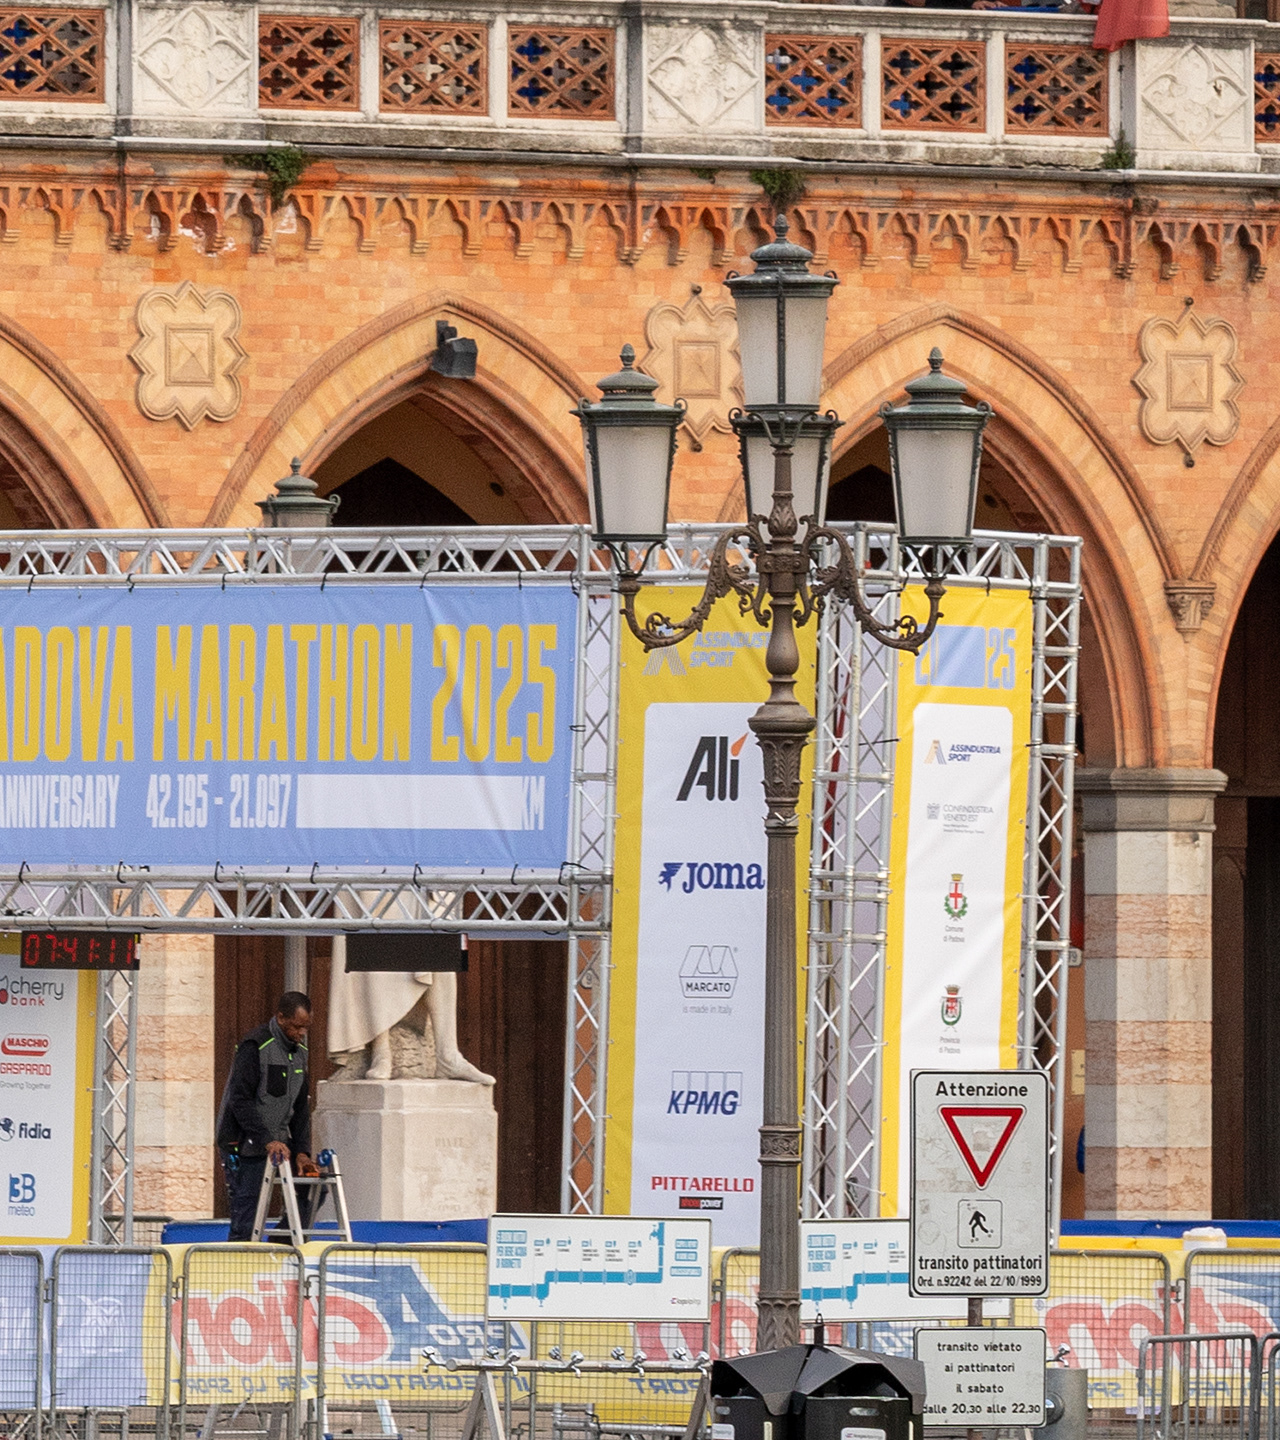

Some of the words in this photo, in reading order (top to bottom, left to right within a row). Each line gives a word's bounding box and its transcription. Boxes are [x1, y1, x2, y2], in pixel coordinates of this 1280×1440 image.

[694, 631, 772, 648] ASSINDUST
[689, 651, 736, 668] SPORT
[152, 624, 413, 762] MARATHON
[430, 624, 558, 763] 2025
[949, 744, 1002, 755] ASSINDUSTRIA
[948, 753, 972, 762] SPORT
[145, 773, 209, 828] 42.195
[229, 773, 292, 828] 21.097
[10, 977, 64, 1000] cherry
[685, 981, 732, 993] MARCATO
[10, 995, 45, 1007] bank
[690, 1005, 708, 1014] made
[718, 1005, 733, 1016] Italy
[7, 1037, 50, 1049] MASCHIO
[0, 1062, 52, 1076] GASPARDO
[935, 1081, 1029, 1097] Attenzione
[667, 1090, 739, 1115] KPMG
[18, 1122, 51, 1140] fidia
[9, 1173, 36, 1204] 3B
[651, 1176, 755, 1192] PITTARELLO
[8, 1205, 36, 1217] meteo
[918, 1255, 969, 1270] transito
[973, 1255, 1043, 1272] pattinatori
[917, 1276, 934, 1287] Ord.
[937, 1275, 971, 1287] n.92242
[974, 1275, 987, 1287] del
[990, 1275, 1042, 1287] 22/10/1999
[937, 1342, 979, 1352] transito
[984, 1342, 1022, 1352] vietato
[944, 1363, 953, 1372] ai
[957, 1363, 1015, 1375] pattinatori
[956, 1384, 962, 1393] il
[968, 1384, 1005, 1393] sabato
[923, 1404, 947, 1414] dalle
[986, 1404, 1007, 1414] alle
